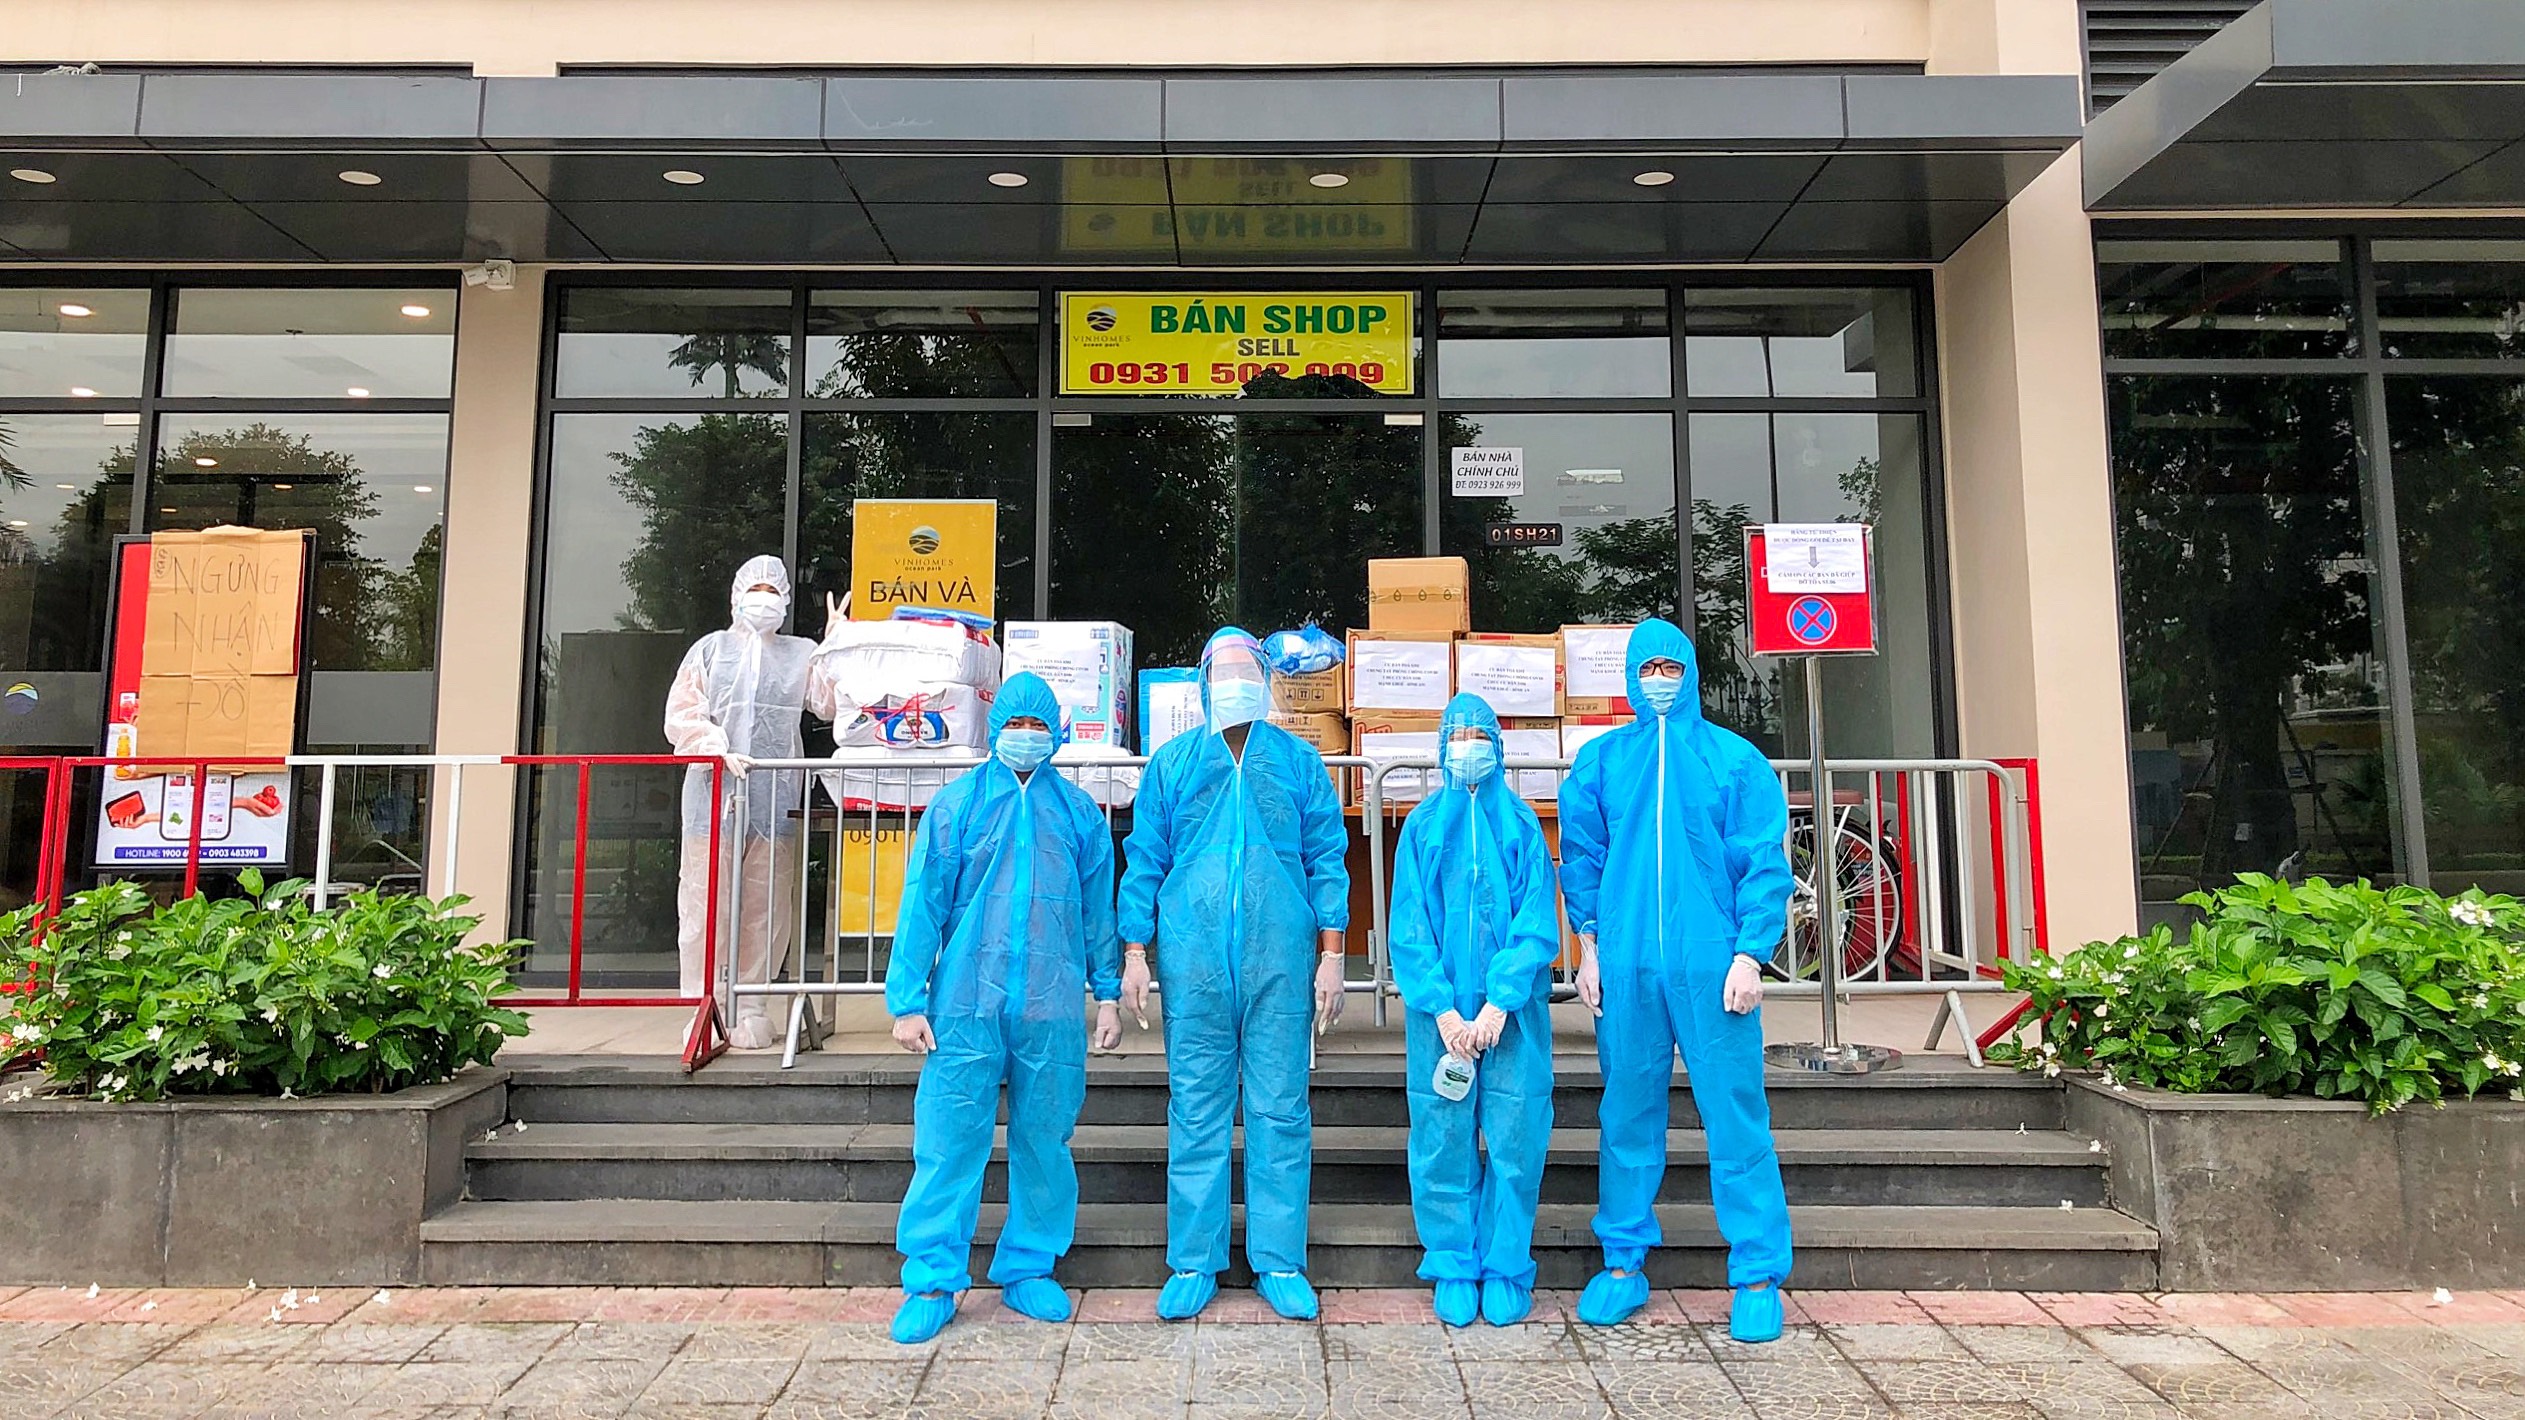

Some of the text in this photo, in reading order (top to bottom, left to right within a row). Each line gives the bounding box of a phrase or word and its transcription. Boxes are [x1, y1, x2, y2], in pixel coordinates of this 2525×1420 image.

[1151, 299, 1387, 334] BÁN SHOP
[1073, 335, 1132, 343] VINHOMES
[1237, 338, 1300, 356] SELL
[1089, 362, 1189, 384] 0931
[1463, 451, 1512, 462] BÁN NHÀ
[1457, 465, 1493, 477] CHÍNH
[1468, 480, 1488, 489] 0923
[1489, 480, 1504, 489] 926
[1506, 480, 1521, 489] 999
[1492, 527, 1556, 541] 01SH21
[894, 558, 954, 566] VINHOMES
[870, 575, 976, 603] BÁN VÀ
[173, 601, 278, 657] NHẬN
[176, 663, 247, 721] ĐỒ
[125, 848, 161, 858] HOTLINE:
[162, 848, 181, 858] 1900
[208, 848, 230, 858] 0903
